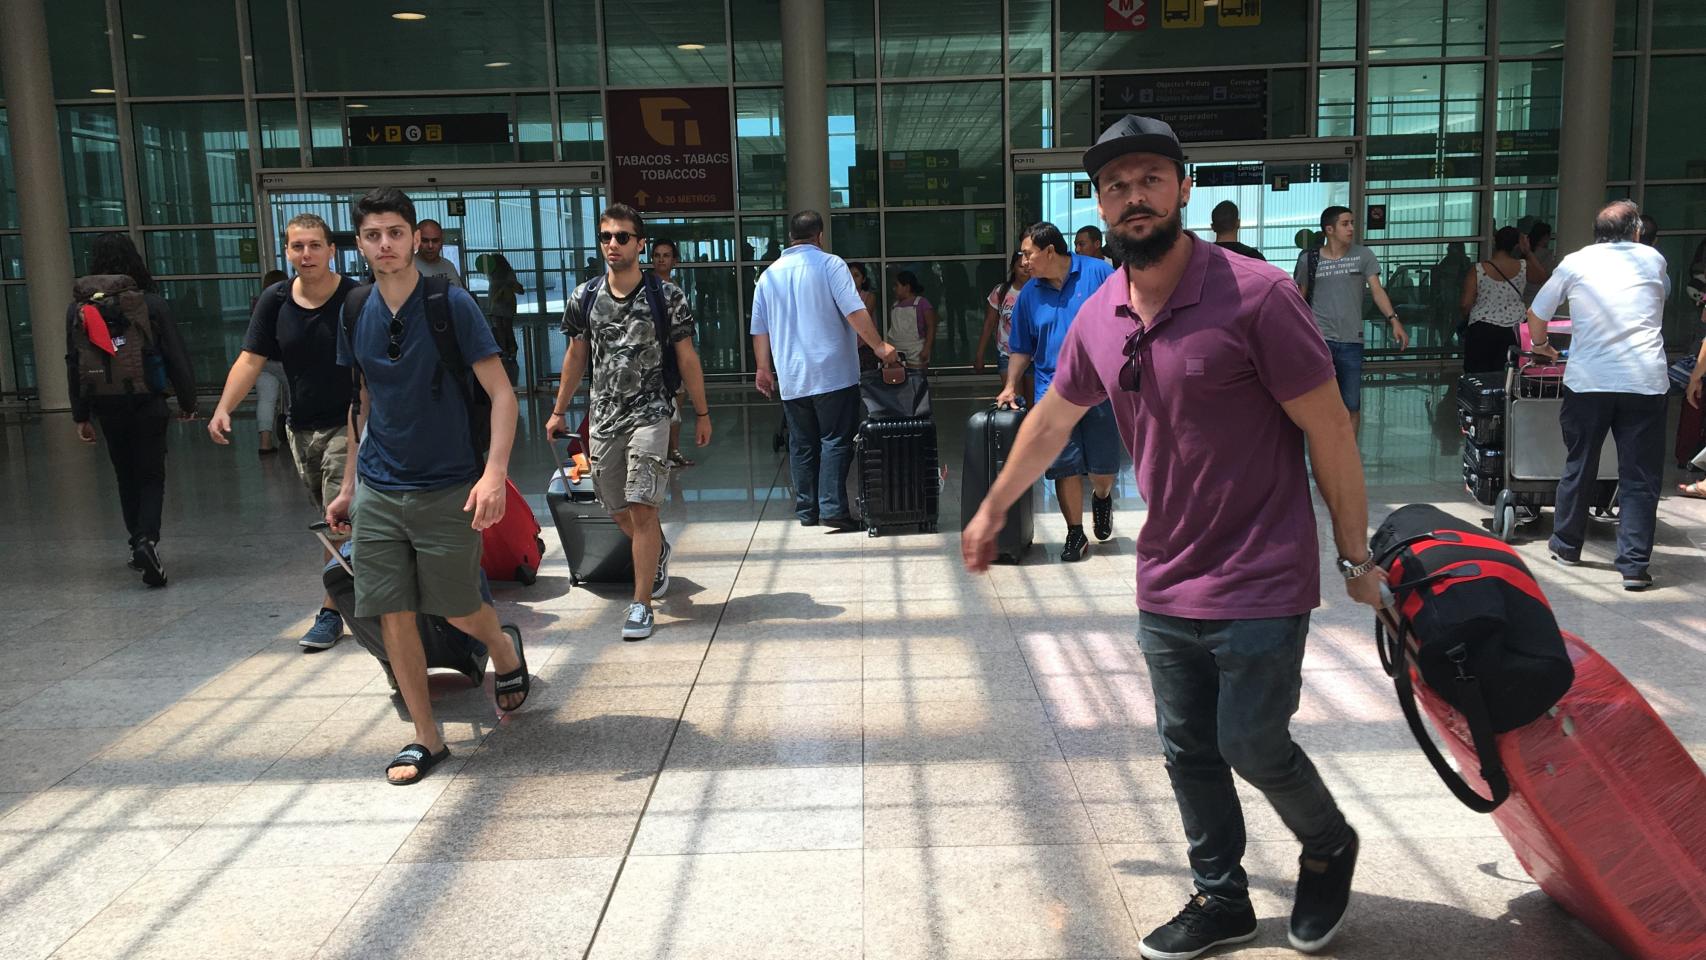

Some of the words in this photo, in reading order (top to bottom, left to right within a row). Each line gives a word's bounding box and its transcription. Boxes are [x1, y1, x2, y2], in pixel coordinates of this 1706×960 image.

[389, 128, 397, 138] P
[409, 128, 417, 138] G
[616, 154, 672, 166] TABACOS
[682, 152, 729, 165] TABACS
[640, 168, 707, 180] TOBACCOS
[665, 195, 676, 204] 20
[677, 193, 717, 204] METROS
